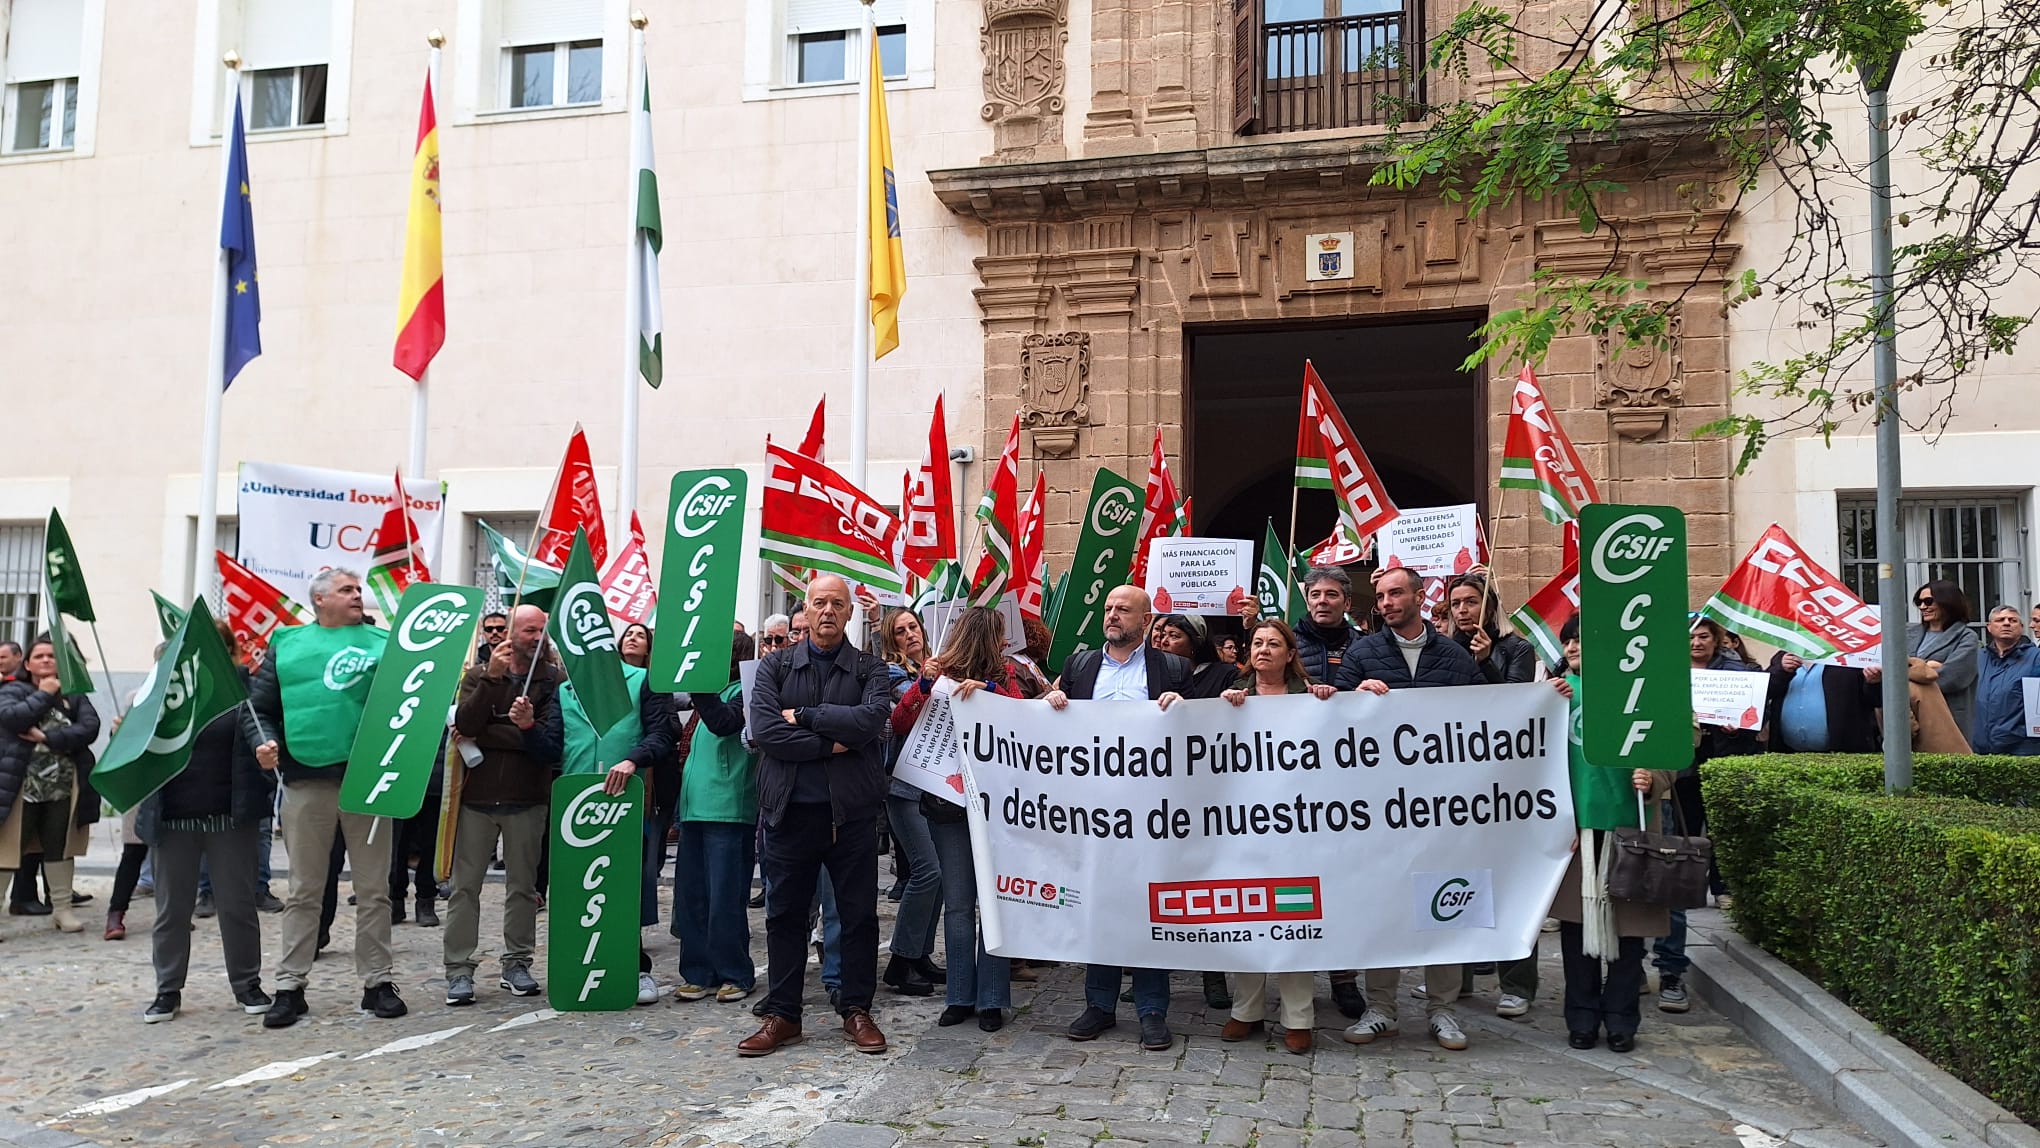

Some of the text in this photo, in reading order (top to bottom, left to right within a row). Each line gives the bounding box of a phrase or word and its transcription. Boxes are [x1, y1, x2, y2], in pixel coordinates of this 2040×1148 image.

[241, 481, 345, 501] ¿Universidad
[687, 494, 737, 517] CSIF
[1101, 499, 1137, 526] CSIF
[1423, 513, 1455, 523] DEFENSA
[1393, 528, 1405, 536] DEL
[1407, 524, 1435, 533] EMPLEO
[1399, 531, 1455, 544] UNIVERSIDADES
[1162, 547, 1236, 558] MÁS FINANCIACIÓN
[1410, 541, 1445, 551] PÚBLICAS
[1607, 534, 1674, 561] CSIF
[1169, 569, 1229, 579] UNIVERSIDADES
[1202, 559, 1216, 567] LAS
[1180, 579, 1217, 588] PÚBLICAS
[414, 609, 471, 634] CSIF
[1797, 599, 1867, 649] Cádiz
[334, 656, 378, 677] CSIF
[913, 698, 940, 760] POR LA DEFENSA
[920, 751, 931, 769] DEL
[926, 724, 943, 754] EMPLEO
[939, 711, 949, 723] EN
[1186, 730, 1321, 776] Pública
[1334, 727, 1380, 768] de
[1393, 717, 1546, 766] Calidad!
[575, 801, 633, 825] CSIF
[1003, 787, 1133, 839] defensa
[1147, 798, 1191, 839] de
[1203, 793, 1371, 837] nuestros
[1385, 782, 1557, 829] derechos
[996, 874, 1038, 897] UGT
[1157, 886, 1268, 916] CCOO
[1439, 890, 1476, 907] CSIF
[1151, 926, 1252, 943] Enseñanza
[1270, 924, 1323, 941] Cádiz
